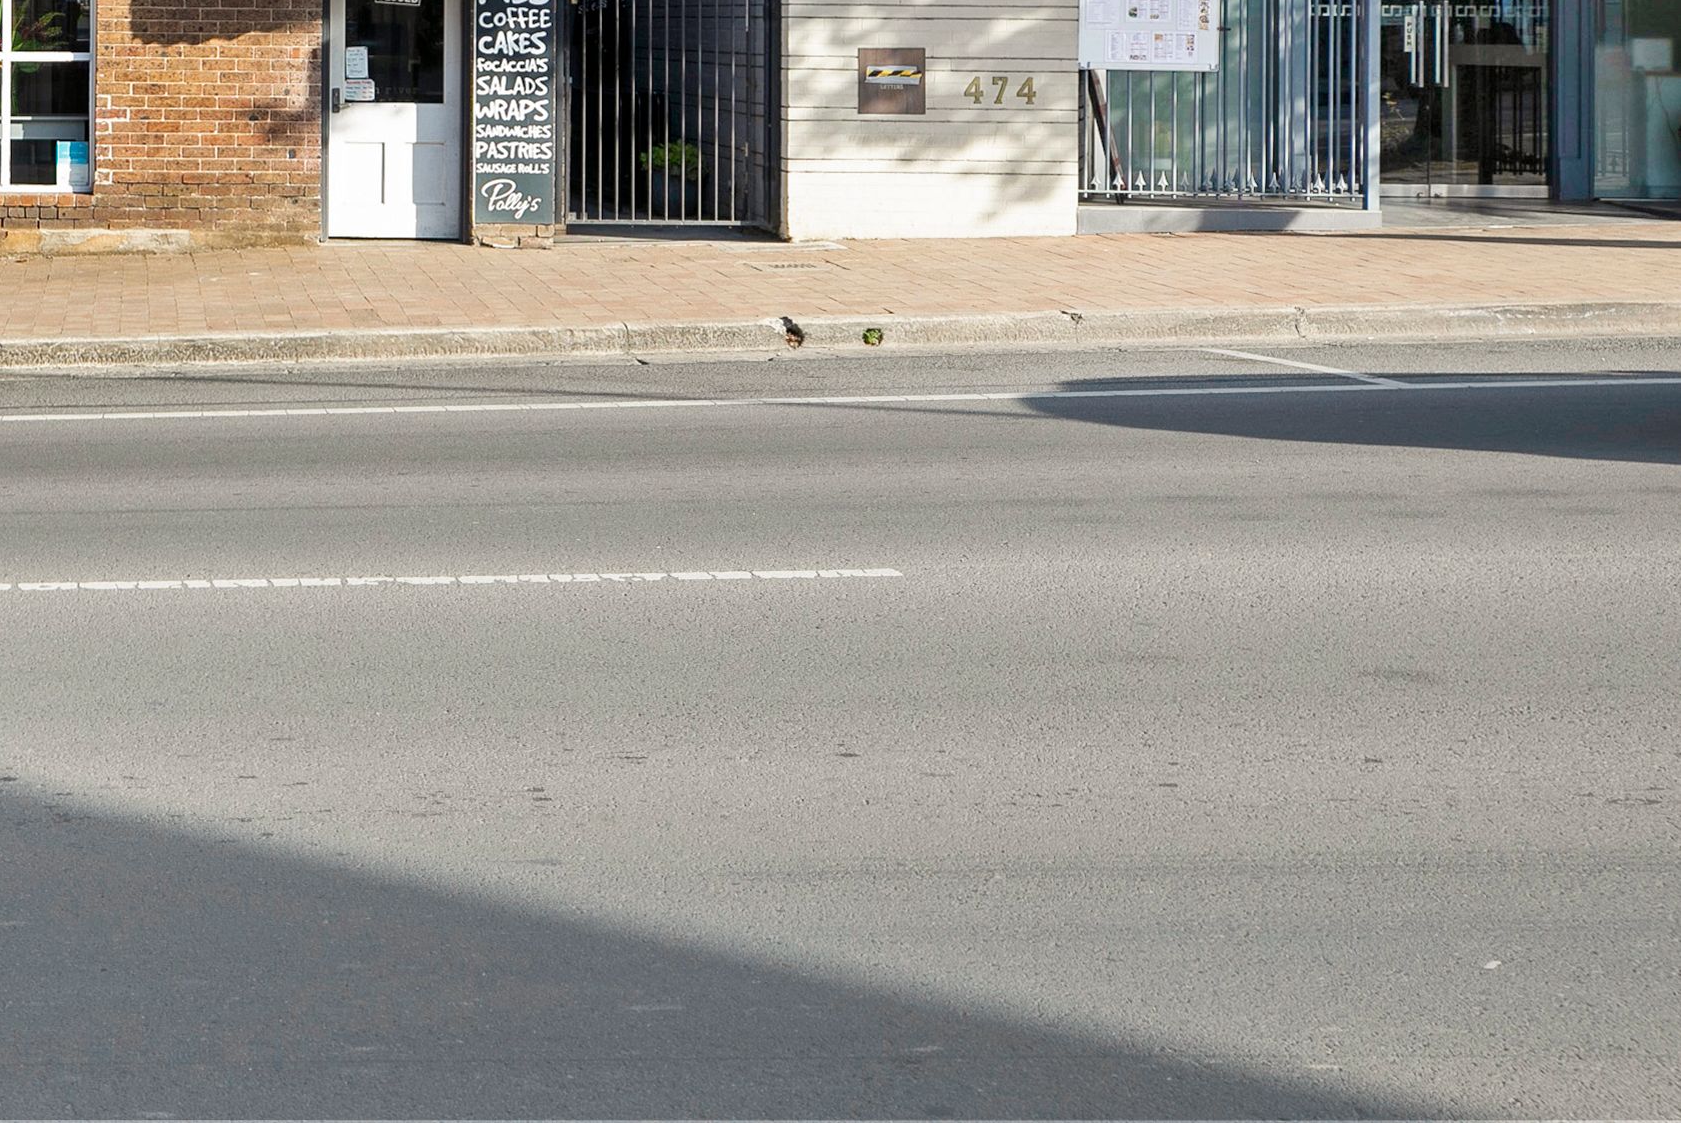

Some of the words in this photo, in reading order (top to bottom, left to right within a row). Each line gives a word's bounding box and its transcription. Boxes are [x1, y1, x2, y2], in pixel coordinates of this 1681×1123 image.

[478, 6, 552, 29] COFFEE
[478, 30, 548, 56] CAKES
[476, 74, 549, 97] SALADS
[963, 76, 1038, 105] 474
[475, 98, 549, 122] WRAPS
[475, 124, 552, 139] SANDWICHES
[475, 141, 553, 160] PASTRIES
[475, 162, 517, 174] SAUSAGE
[481, 178, 542, 220] Polly's
